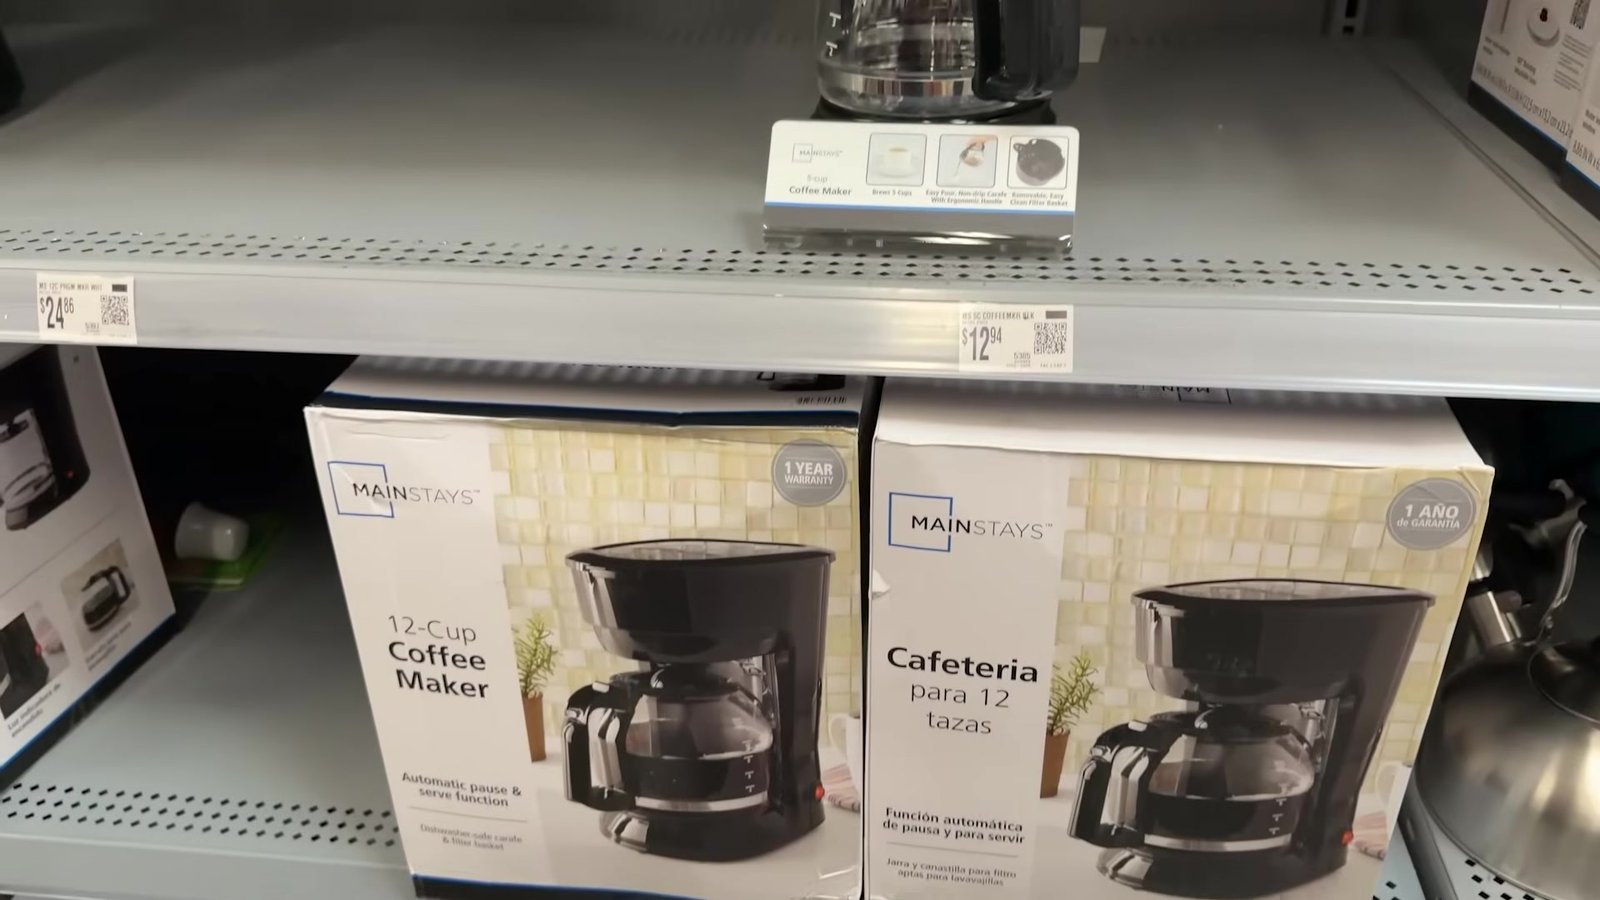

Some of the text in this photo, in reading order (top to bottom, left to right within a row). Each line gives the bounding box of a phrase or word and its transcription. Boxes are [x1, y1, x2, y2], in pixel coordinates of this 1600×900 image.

[788, 185, 852, 195] Coffee Maker
[784, 461, 834, 475] 1 YEAR
[784, 474, 834, 485] WARRANTY
[1405, 502, 1459, 519] 1 AÑO
[1396, 517, 1460, 529] de GARANTÍA
[388, 615, 477, 646] 12-Cup
[388, 641, 486, 671] Coffee
[887, 647, 1038, 682] Cafeteria
[396, 669, 489, 698] Maker
[911, 683, 1009, 708] para 12
[926, 711, 992, 735] tazas
[402, 772, 521, 796] Automatic pause &
[419, 788, 509, 807] serve function
[882, 819, 1025, 844] de pausa y para servir
[886, 807, 1023, 832] Función automática
[887, 857, 1017, 878] Jarra y canastilla para filtro
[898, 868, 1003, 886] aptas para lavavajillas
